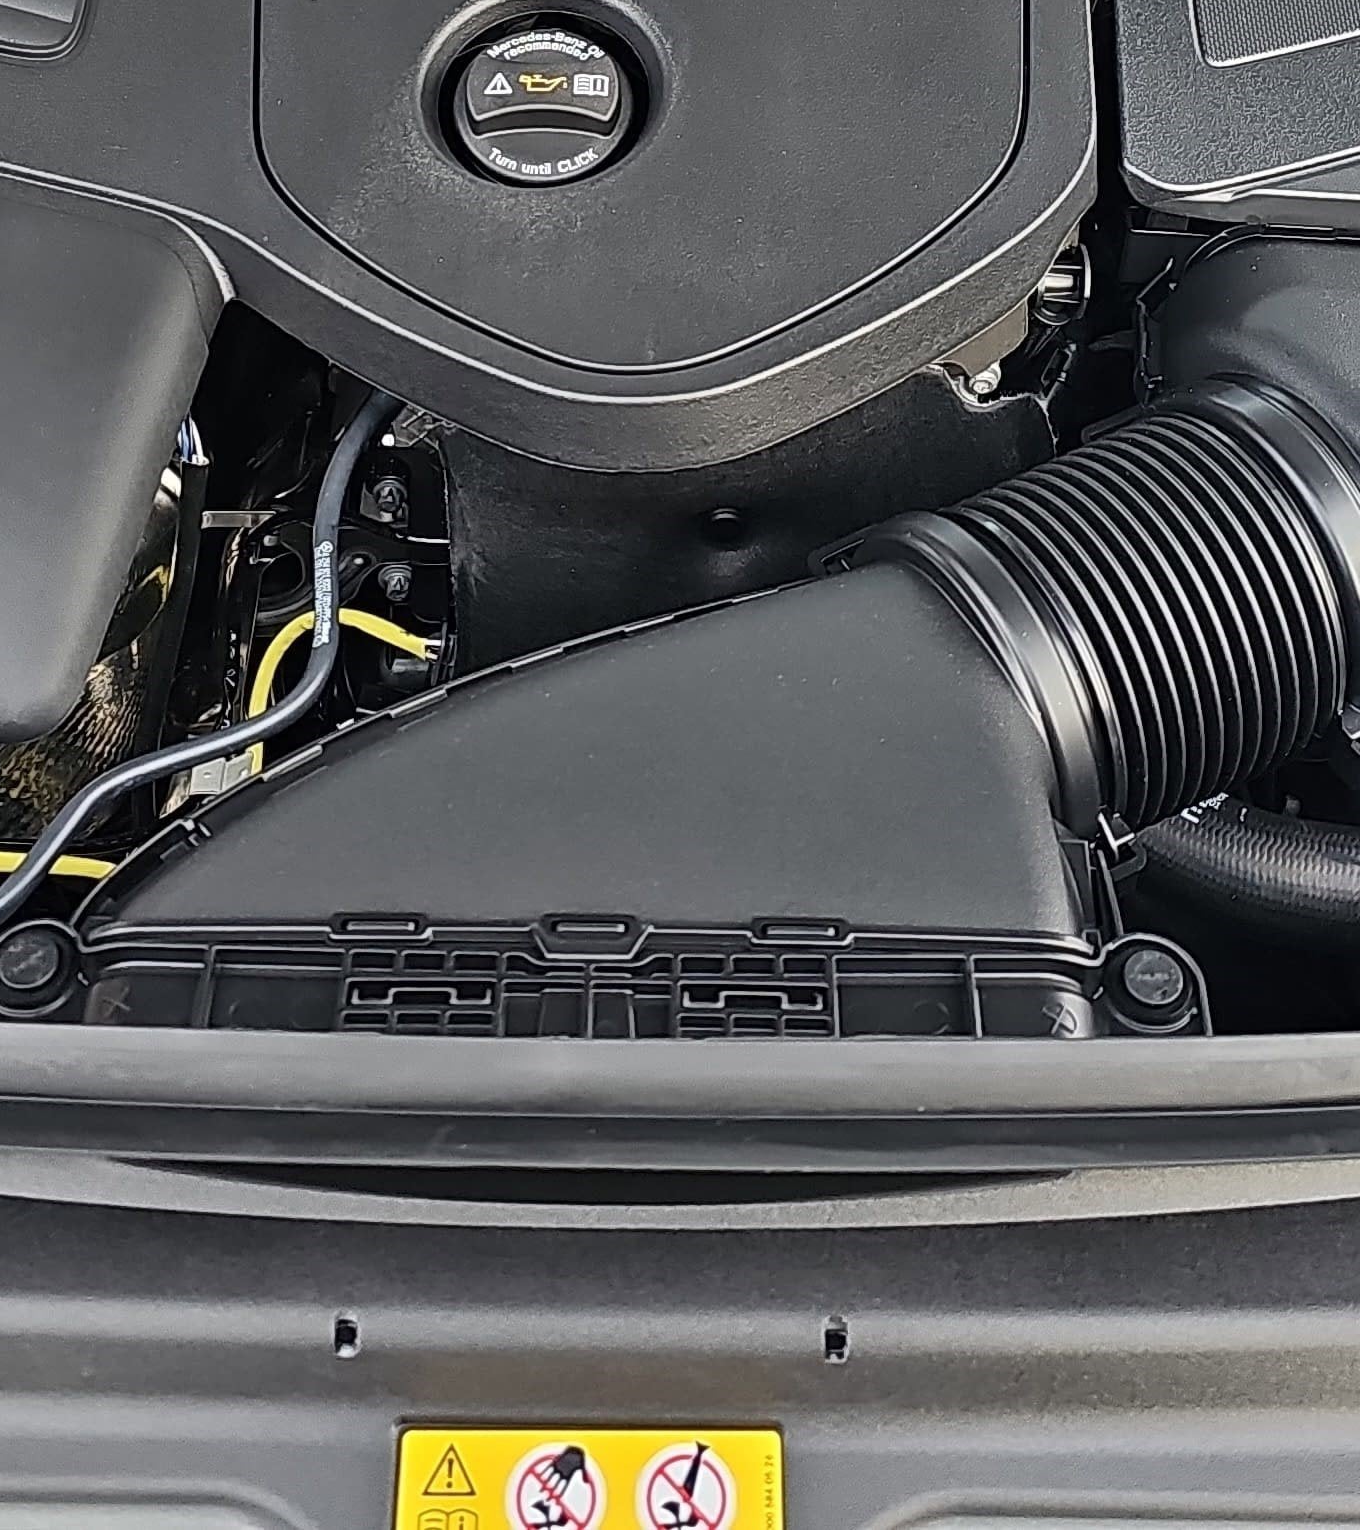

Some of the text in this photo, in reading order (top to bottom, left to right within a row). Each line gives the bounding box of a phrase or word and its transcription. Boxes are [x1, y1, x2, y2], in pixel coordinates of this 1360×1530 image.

[486, 31, 588, 59] Mercedes-Benz
[503, 41, 590, 61] recommended
[489, 147, 599, 175] Turn until CLICK
